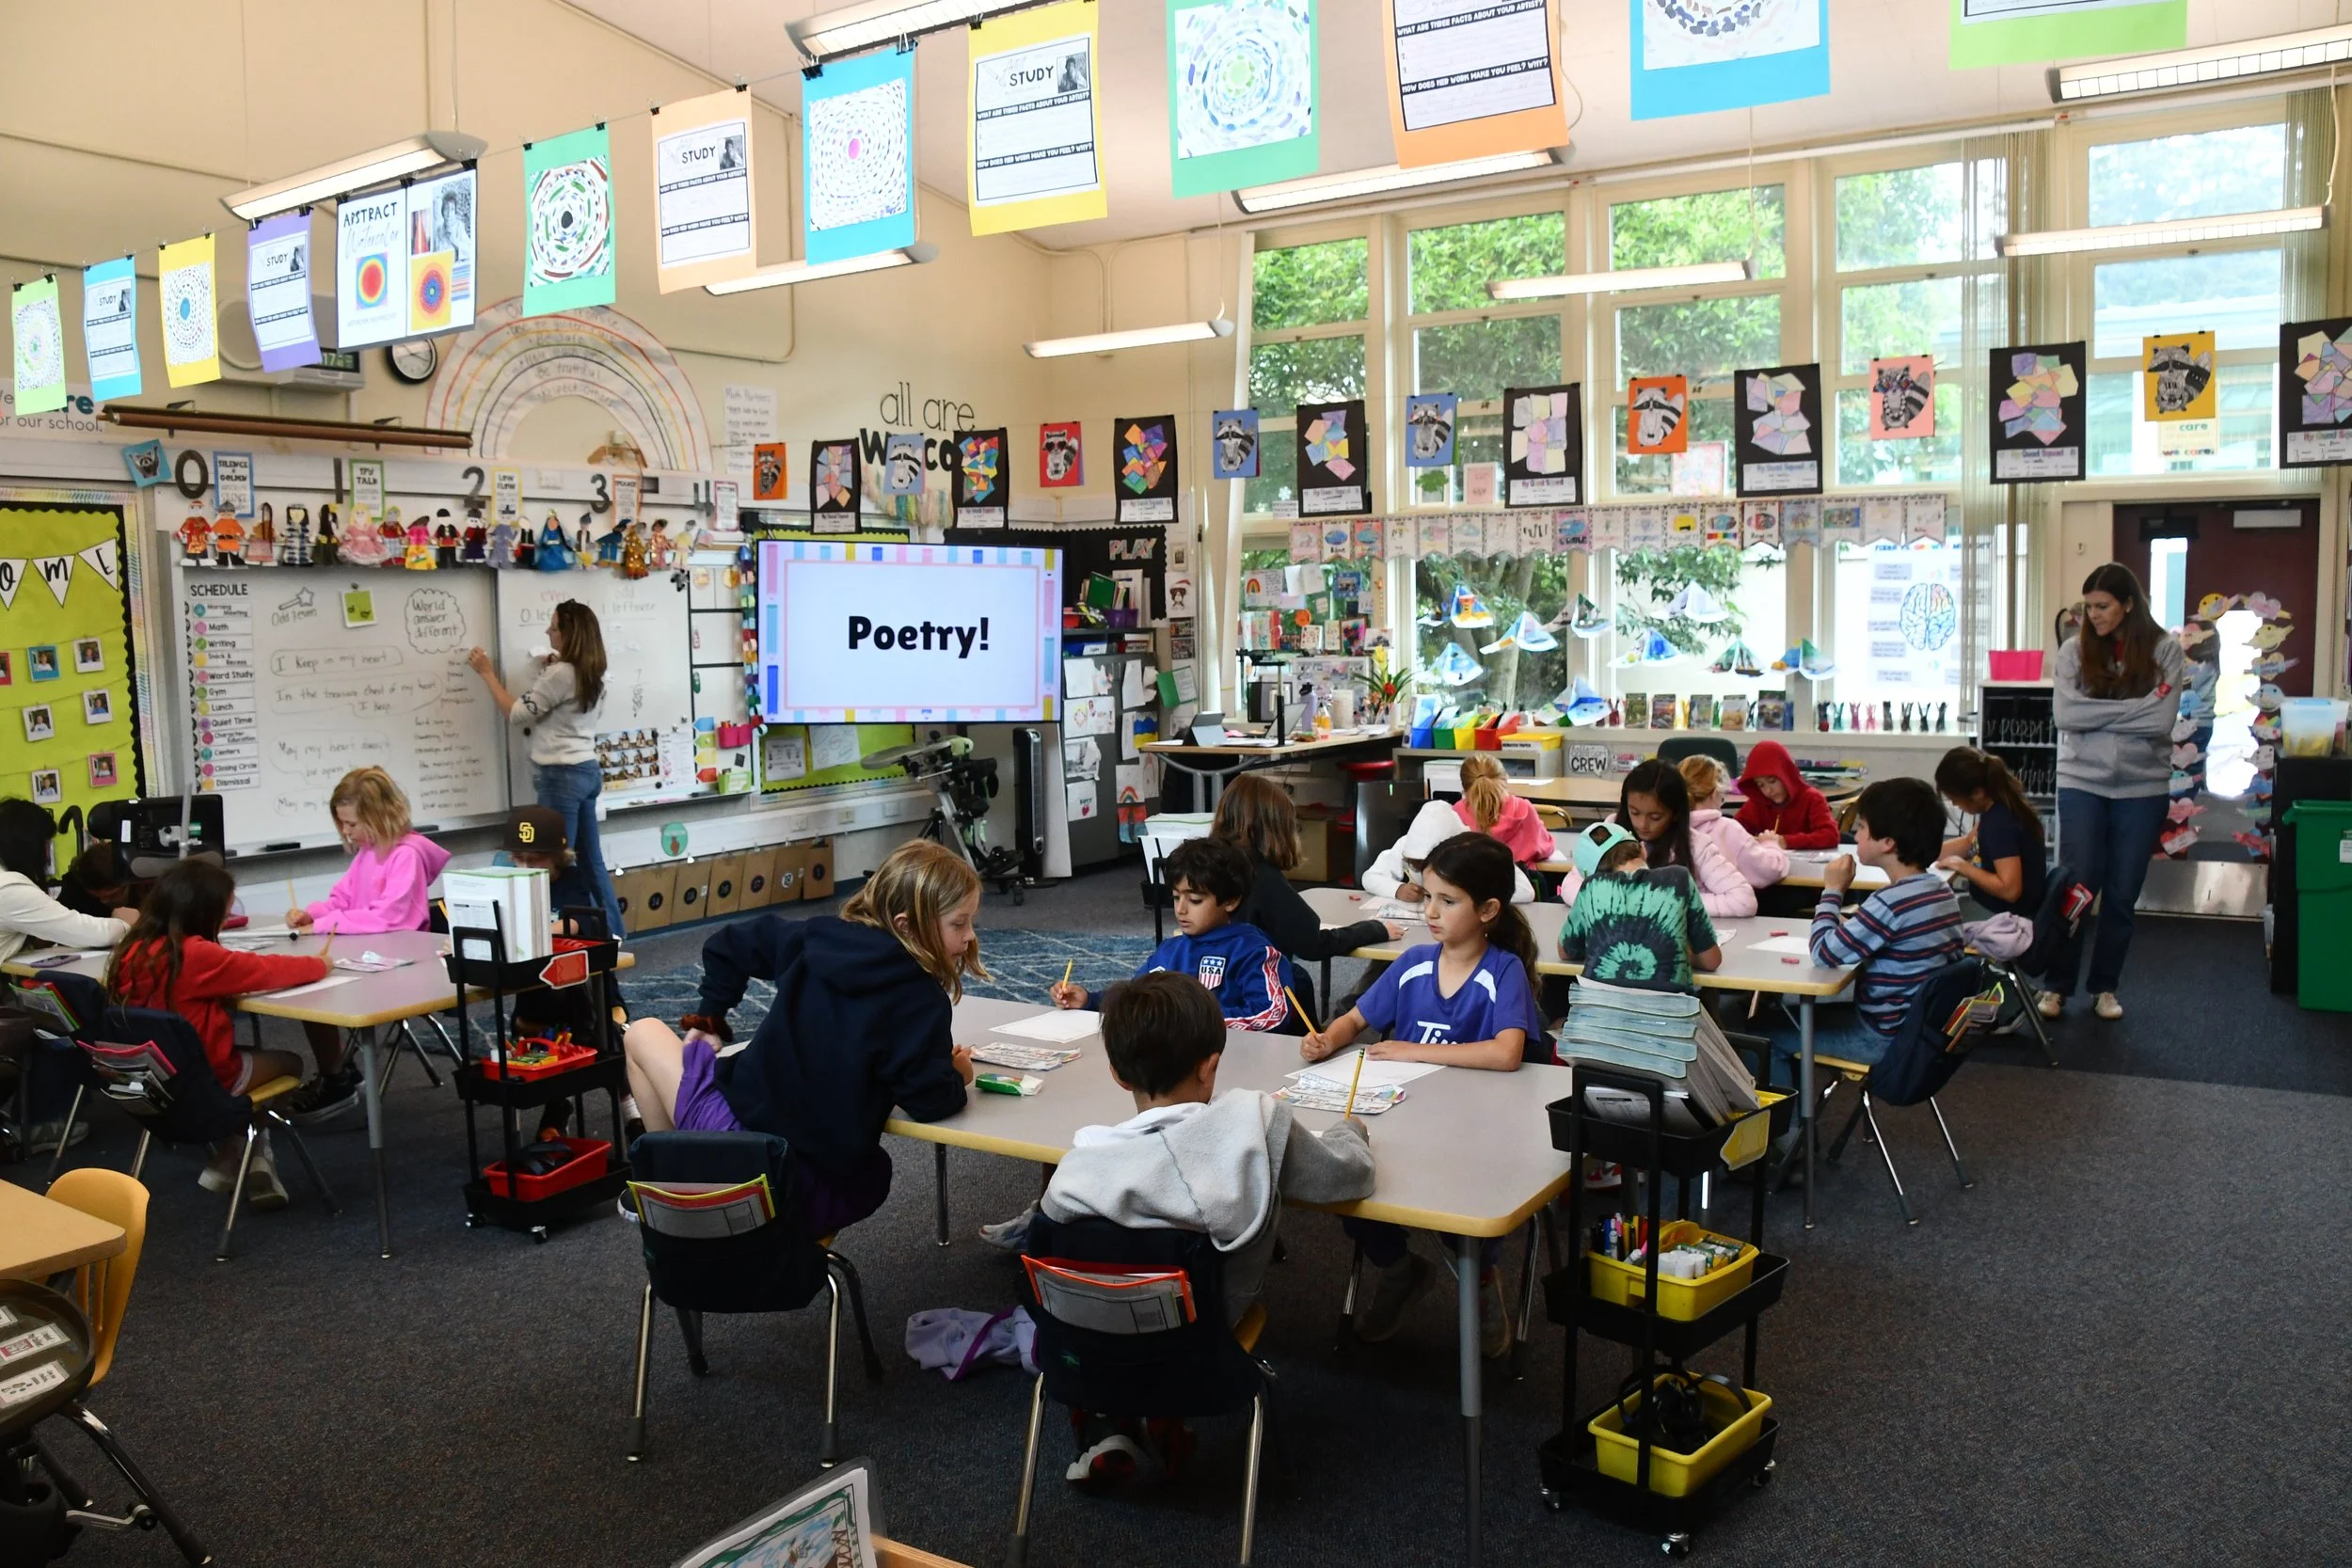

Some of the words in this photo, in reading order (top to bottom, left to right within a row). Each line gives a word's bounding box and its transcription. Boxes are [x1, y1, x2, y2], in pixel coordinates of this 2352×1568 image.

[1397, 26, 1415, 36] WHAT
[1452, 15, 1472, 24] FACTS
[1474, 11, 1495, 21] ABOUT
[1497, 7, 1516, 16] YOUR
[1517, 0, 1544, 12] ARTIST?
[1009, 66, 1054, 87] STUDY
[1402, 83, 1417, 92] HOW
[1419, 80, 1435, 90] DOES
[1451, 74, 1470, 84] WORK
[1470, 71, 1489, 80] MAKE
[1491, 67, 1505, 76] YOU
[1507, 62, 1526, 73] FEEL?
[1528, 58, 1548, 69] WHY?
[681, 146, 716, 164] STUDY
[1047, 149, 1058, 157] YOU
[1076, 143, 1092, 152] WHY?
[266, 254, 288, 267] STUDY
[99, 295, 118, 306] STUDY
[0, 390, 14, 404] e
[880, 382, 913, 427] all
[923, 399, 976, 432] are
[17, 416, 42, 428] our
[49, 414, 103, 432] school.
[2179, 421, 2208, 431] care
[2022, 450, 2041, 458] Quad
[590, 473, 611, 514] 3
[1109, 538, 1157, 561] PLAY
[190, 584, 248, 596] SCHEDULE
[612, 602, 657, 612] leftover
[272, 612, 291, 626] Odd
[413, 613, 449, 624] answer
[208, 640, 236, 648] Writing
[848, 616, 990, 659] Poetry!
[277, 656, 286, 673] I
[324, 656, 334, 664] in
[340, 655, 357, 668] my
[361, 651, 387, 663] heart
[232, 670, 254, 678] Study
[209, 689, 226, 697] Gym
[276, 689, 293, 702] In
[300, 687, 317, 700] the
[401, 686, 415, 696] my
[358, 701, 367, 711] I
[212, 719, 231, 727] Quiet
[304, 744, 322, 759] my
[329, 736, 355, 752] heart
[1571, 757, 1607, 771] CREW
[321, 766, 343, 779] open
[216, 777, 250, 786] Dismissal
[519, 822, 534, 843] SD
[1201, 966, 1221, 974] USA
